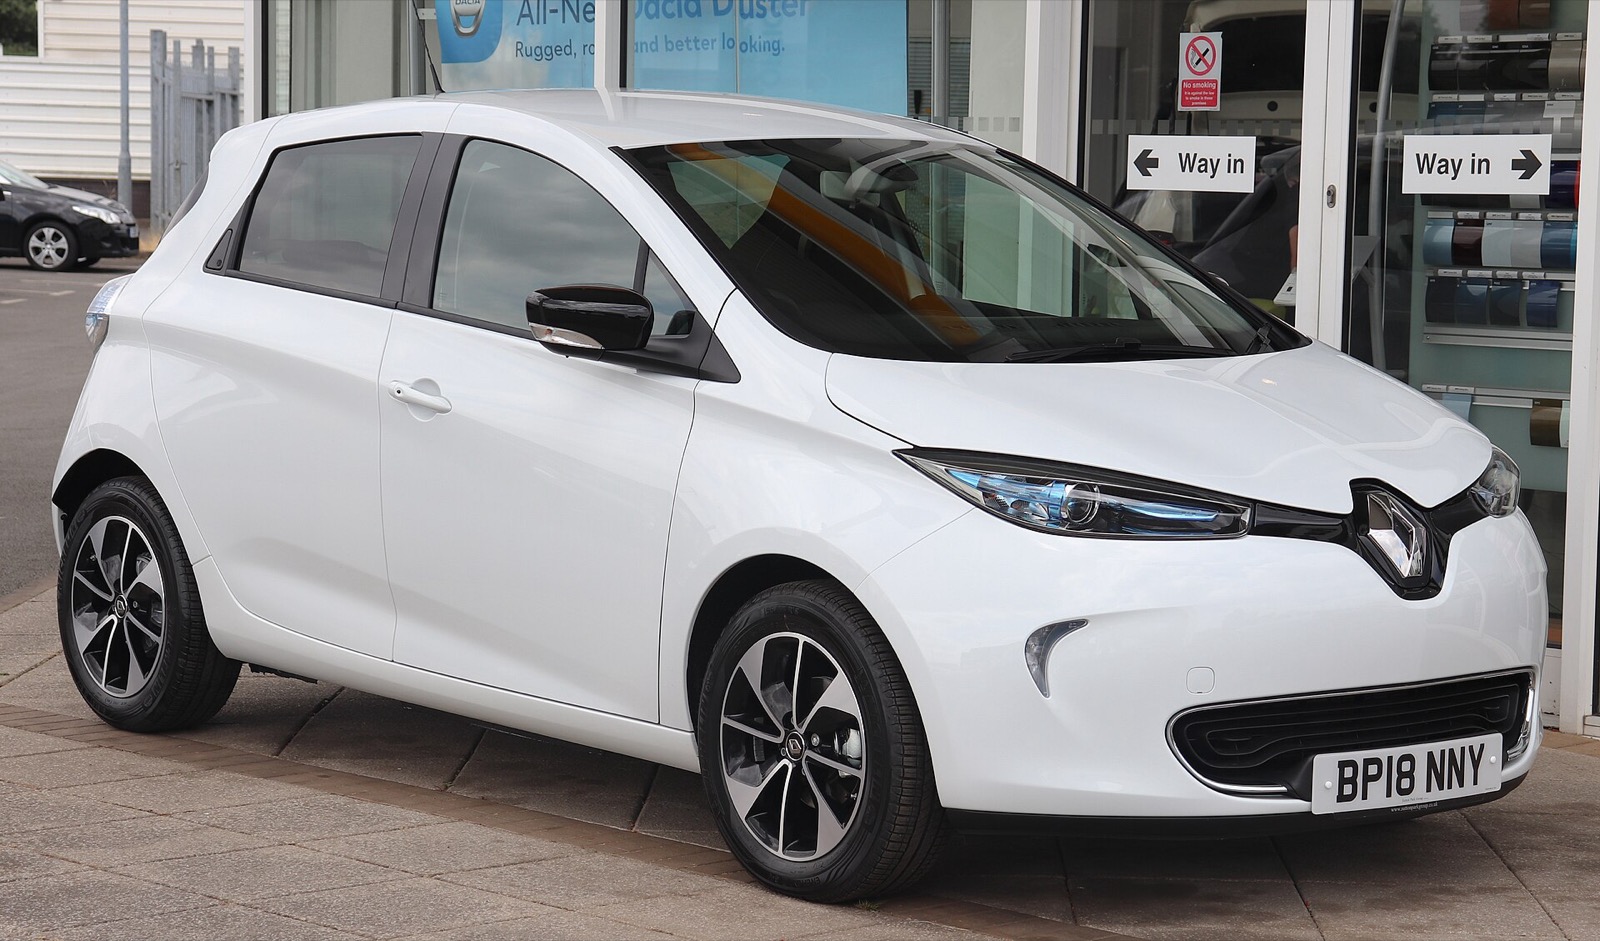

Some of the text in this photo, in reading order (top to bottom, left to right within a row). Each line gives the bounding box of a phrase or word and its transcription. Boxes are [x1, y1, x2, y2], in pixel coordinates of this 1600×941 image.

[516, 0, 595, 26] All-Ne
[515, 39, 577, 62] Rugged,
[664, 34, 717, 53] better
[1192, 81, 1216, 89] smoking
[1178, 152, 1245, 179] Way in
[1415, 153, 1491, 181] Way in
[1336, 743, 1485, 803] BP18 NNY
